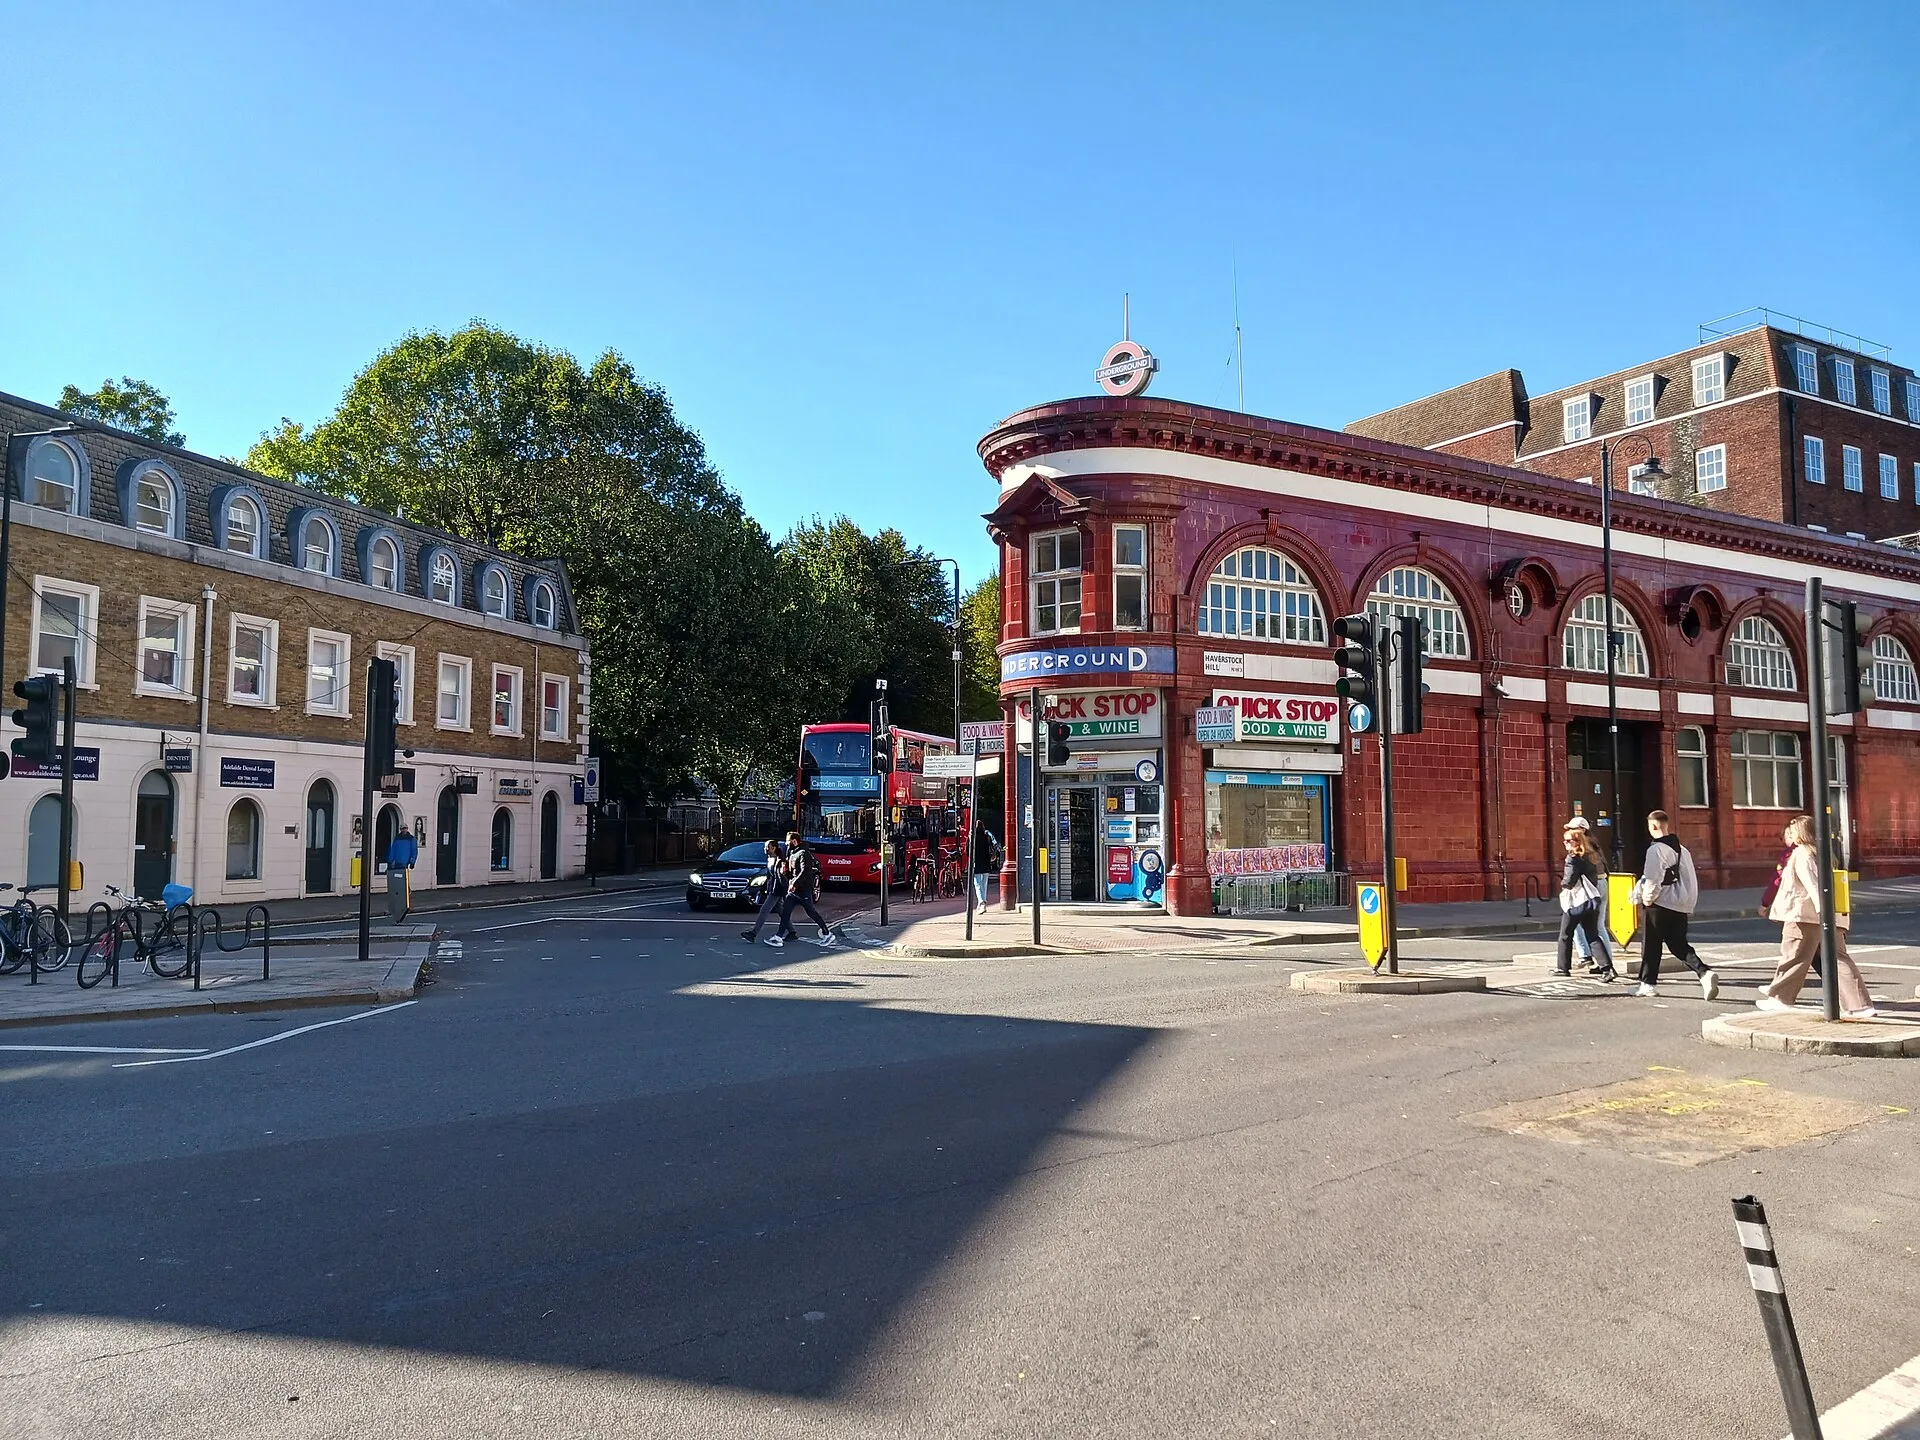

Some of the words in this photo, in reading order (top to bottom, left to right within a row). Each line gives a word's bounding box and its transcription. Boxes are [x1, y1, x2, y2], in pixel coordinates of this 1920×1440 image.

[1096, 359, 1148, 378] UNDERGROUND
[1004, 647, 1148, 676] NDERGROUND
[1204, 655, 1243, 664] HAVERSTOCK
[1204, 663, 1220, 671] HILL
[1019, 696, 1087, 721] QICK
[1093, 693, 1157, 718] STOP
[1286, 699, 1338, 722] STOP
[1197, 709, 1212, 725] FOOD
[1213, 709, 1218, 723] &
[1219, 707, 1233, 724] WINE
[963, 725, 980, 738] FOOD
[981, 725, 987, 737] &
[988, 724, 1004, 737] WINE
[1082, 723, 1092, 735] &
[1099, 720, 1138, 734] WINE
[1241, 722, 1271, 735] OOD
[1277, 723, 1286, 736] &
[1293, 724, 1327, 738] WINE
[1197, 730, 1210, 742] OPEN
[1210, 730, 1217, 740] 24
[1217, 728, 1233, 740] HOURS
[963, 742, 975, 752] OPE
[986, 740, 1005, 751] HOURS
[257, 766, 273, 774] Lounge
[811, 780, 836, 788] Camden
[836, 780, 852, 788] Town
[862, 778, 873, 789] 31
